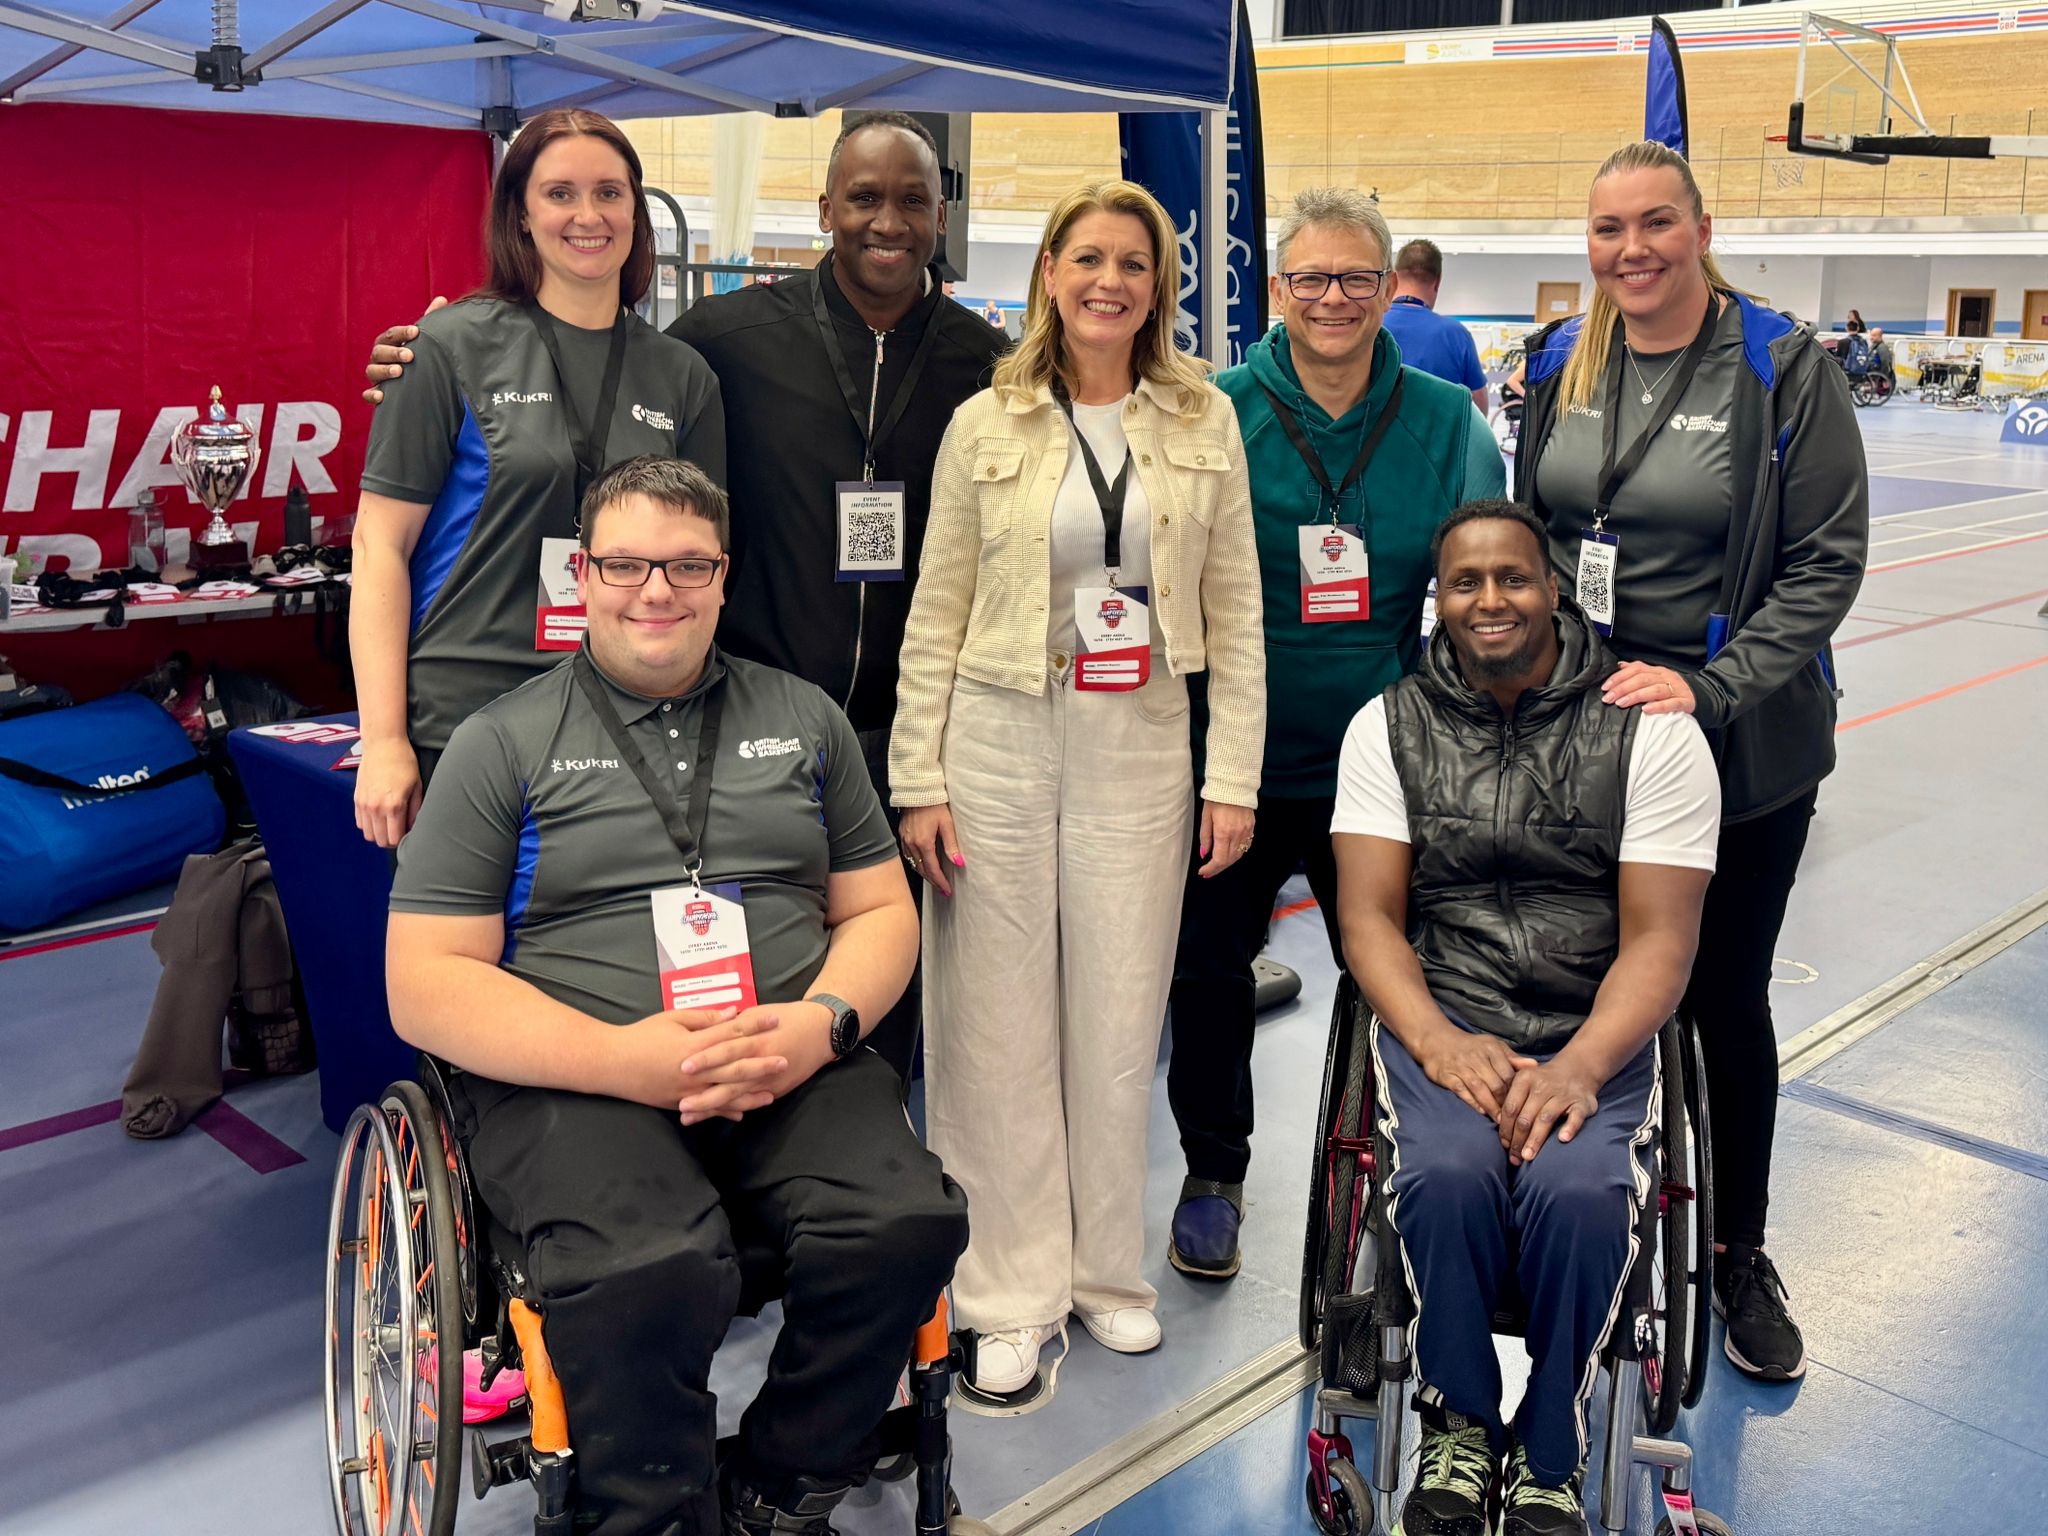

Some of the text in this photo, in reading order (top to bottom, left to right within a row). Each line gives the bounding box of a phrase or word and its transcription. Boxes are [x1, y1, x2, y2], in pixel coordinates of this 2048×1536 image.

[2016, 352, 2045, 364] ARENA
[504, 392, 552, 404] KUKRI
[1568, 403, 1602, 419] KUKRI
[0, 401, 342, 512] HAIR
[565, 758, 620, 771] KUKRI
